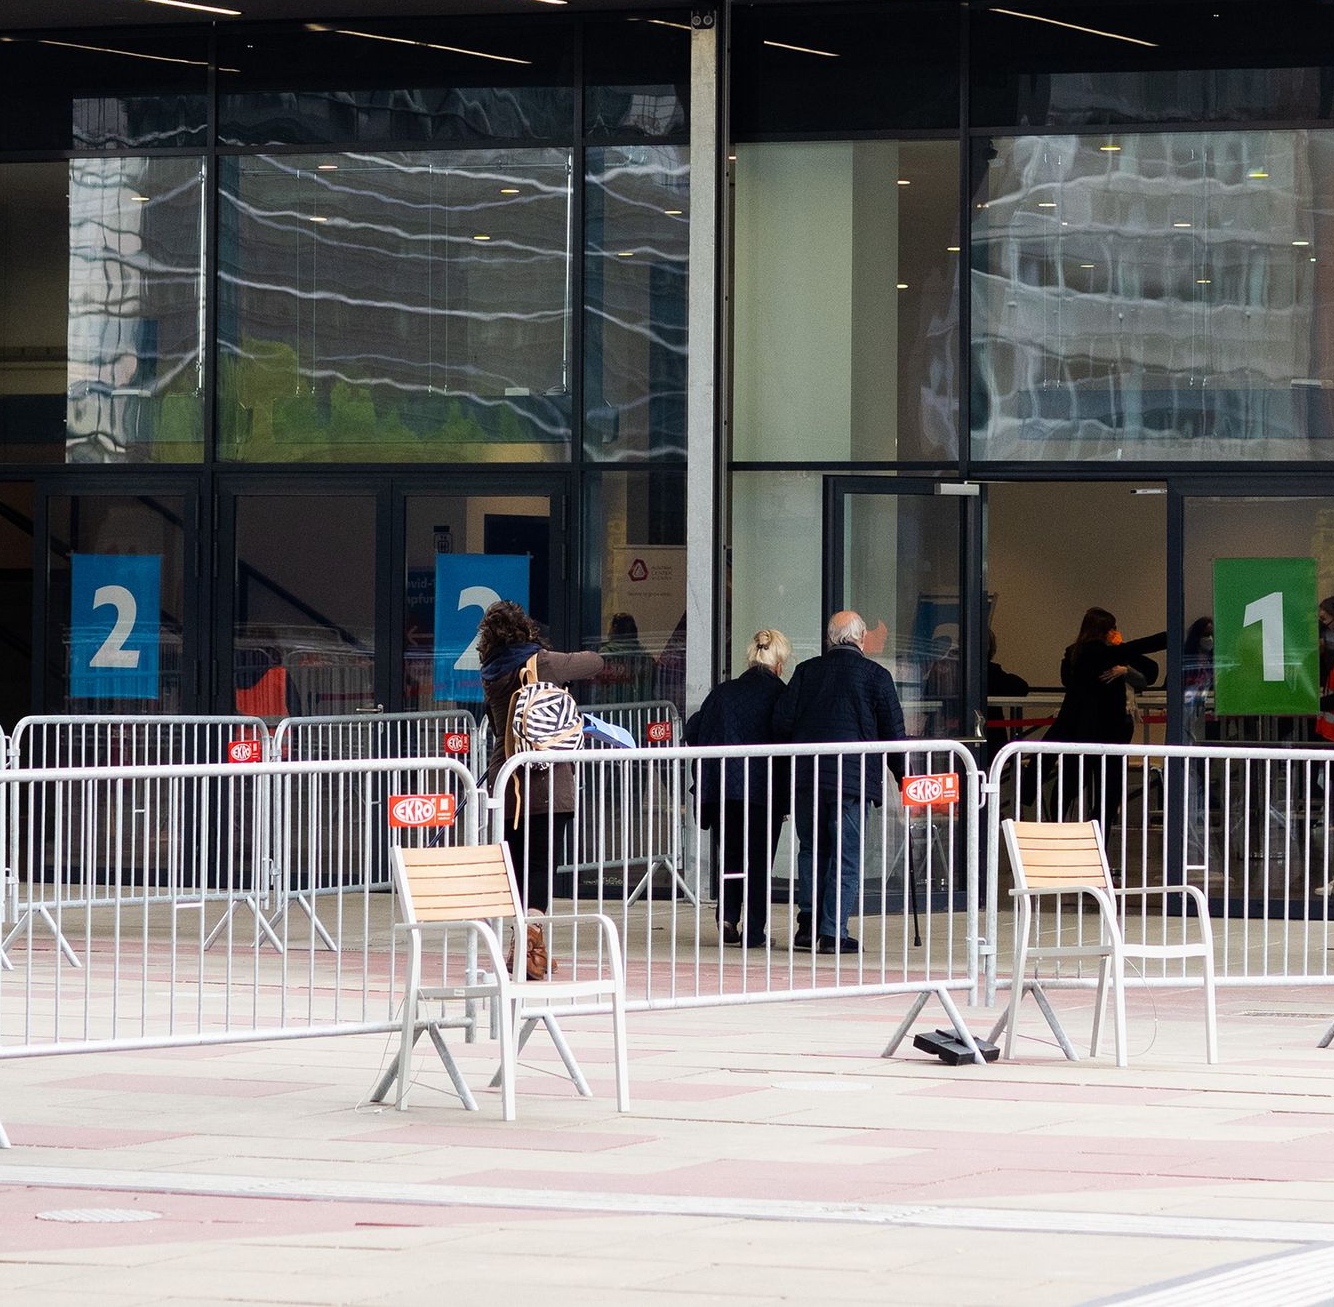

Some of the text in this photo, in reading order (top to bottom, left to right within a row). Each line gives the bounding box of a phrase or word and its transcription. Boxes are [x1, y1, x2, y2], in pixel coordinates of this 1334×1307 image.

[88, 585, 140, 669] 2
[453, 585, 503, 671] 2
[1243, 591, 1285, 682] 1
[395, 800, 433, 821] EKRO
[908, 781, 940, 800] EKRO
